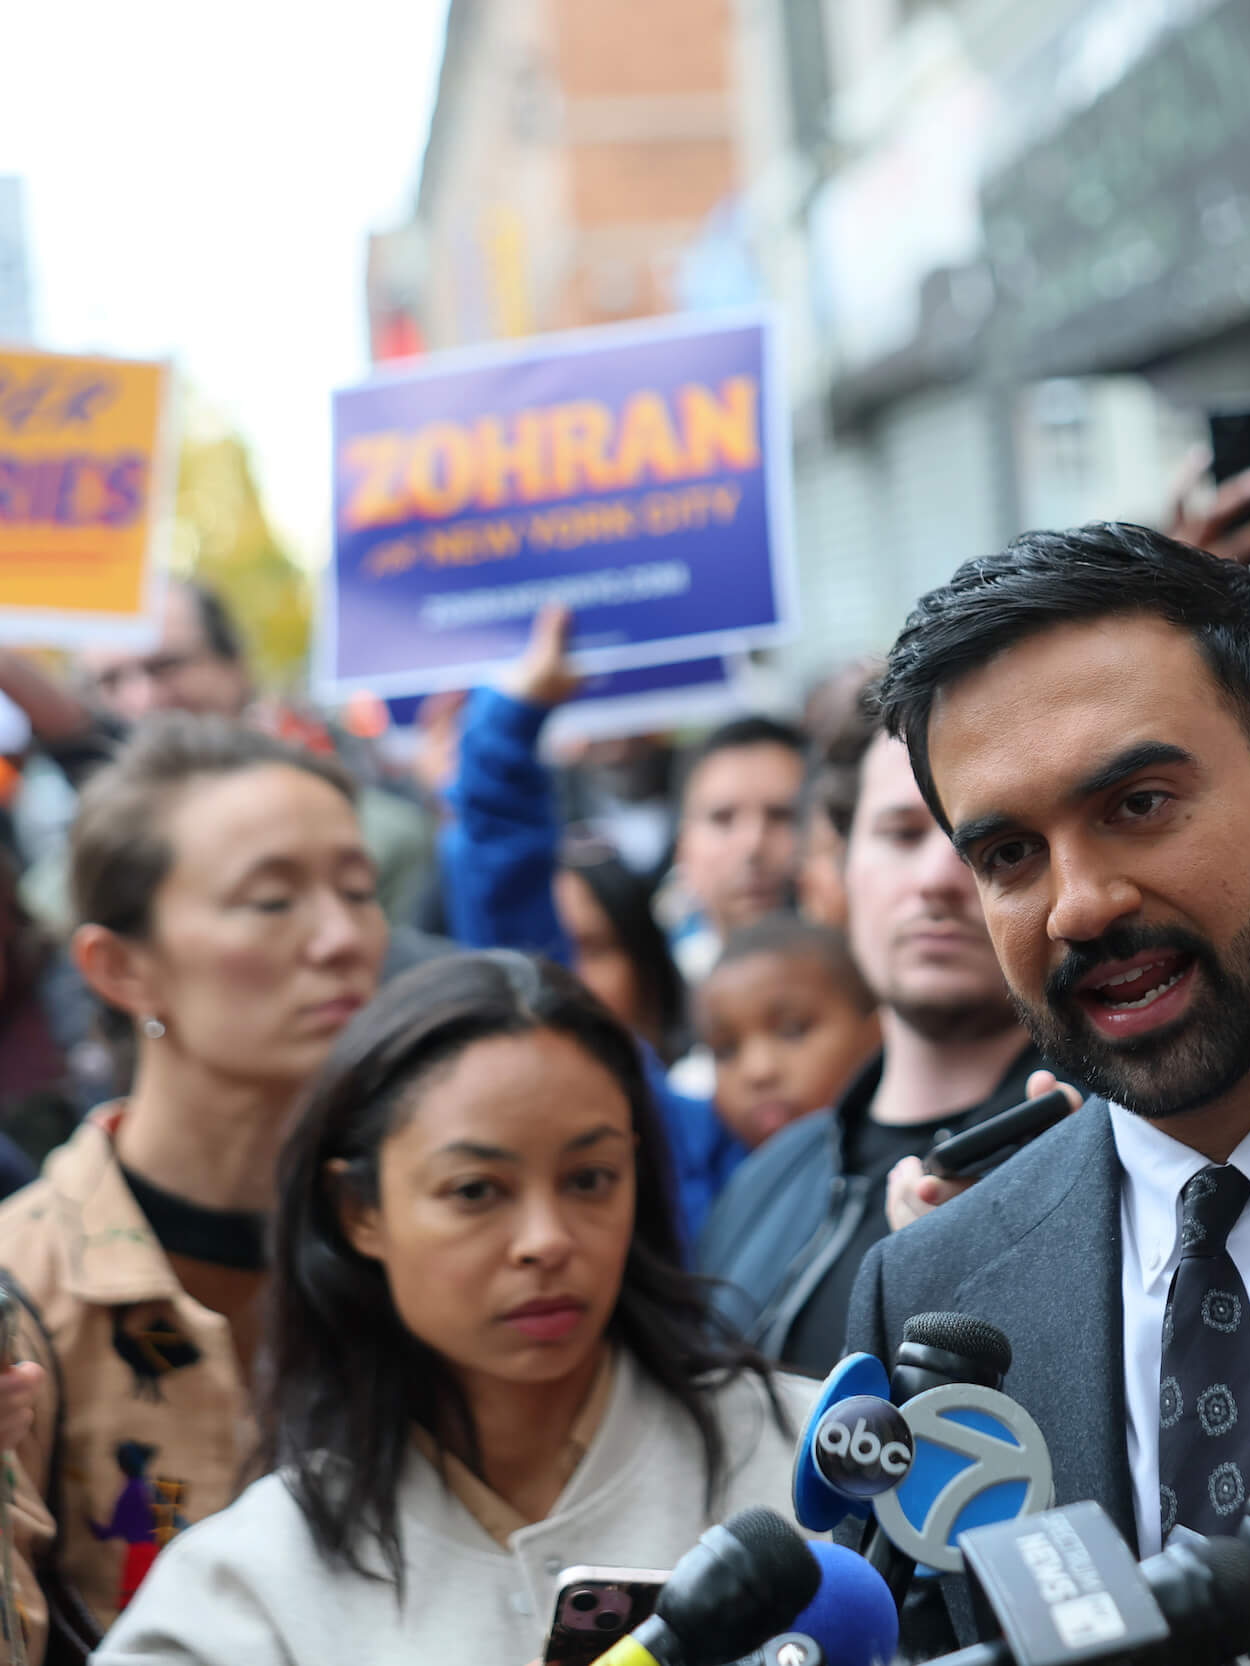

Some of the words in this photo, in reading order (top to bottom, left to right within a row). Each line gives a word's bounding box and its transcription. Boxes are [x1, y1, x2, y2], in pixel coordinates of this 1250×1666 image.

[340, 374, 758, 532] ZOHRAN
[818, 1417, 912, 1476] abc
[1015, 1531, 1080, 1604] NEWS
